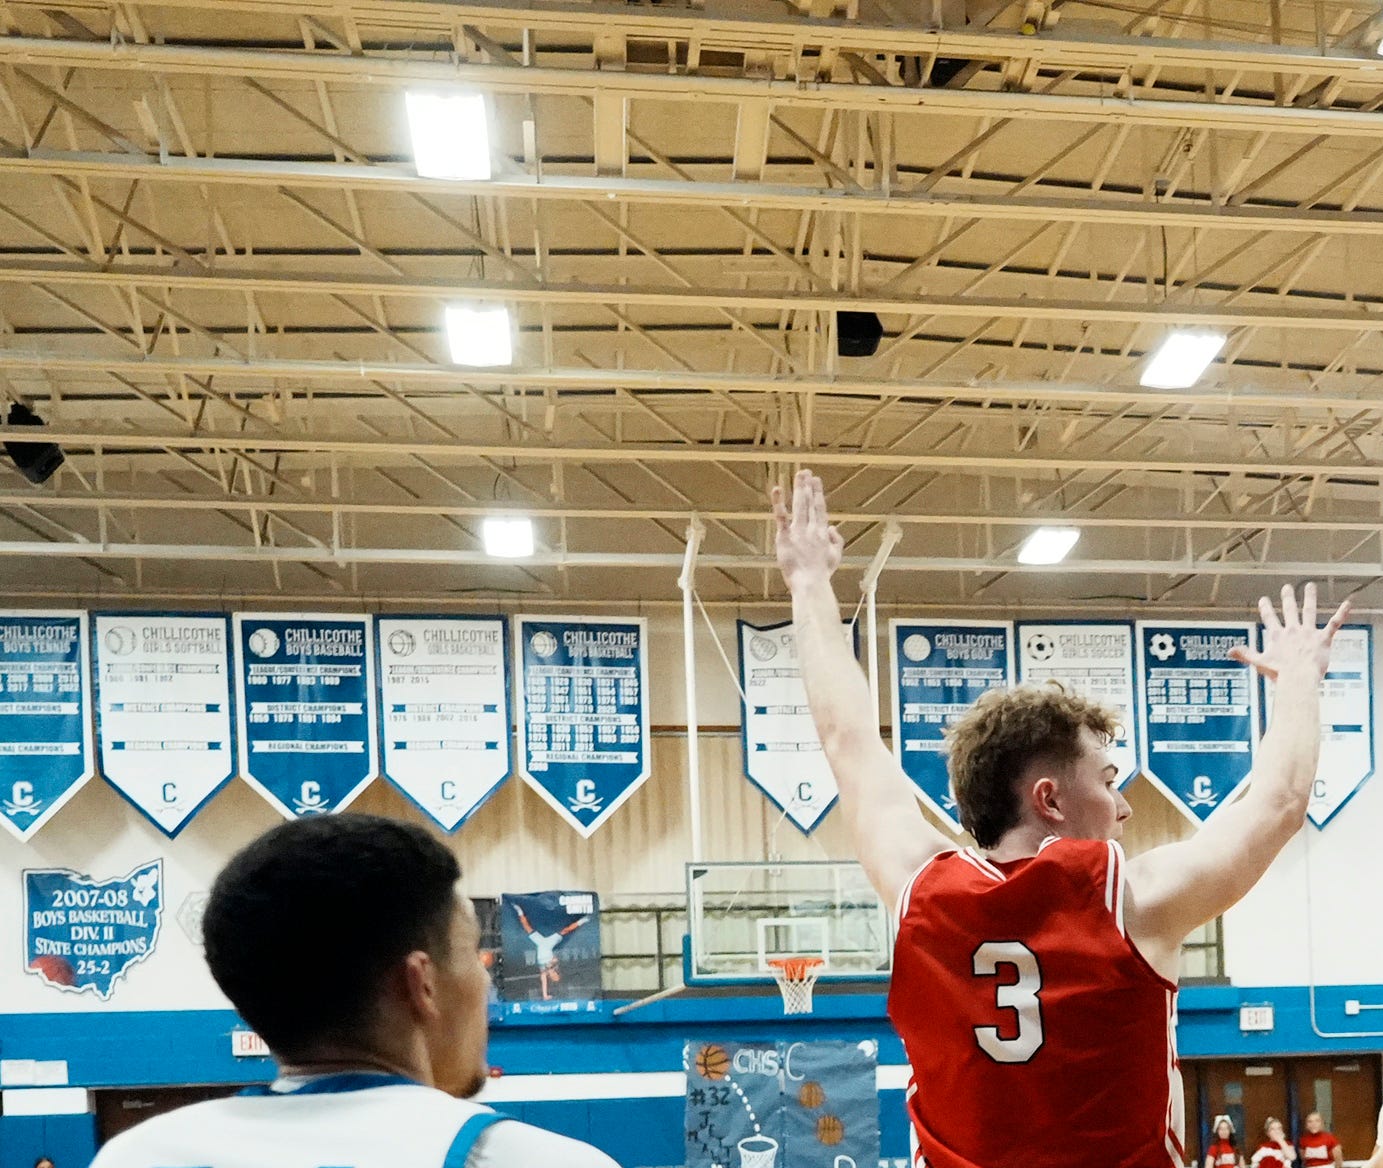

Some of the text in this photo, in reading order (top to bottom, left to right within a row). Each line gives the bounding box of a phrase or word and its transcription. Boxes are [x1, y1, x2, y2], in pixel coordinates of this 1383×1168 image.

[142, 627, 221, 640] CHILLICOTHE
[285, 628, 363, 643] CHILLICOTHE
[423, 629, 499, 642] CHILLICOTHE
[563, 630, 638, 645] CHILLICOTHE
[1059, 634, 1127, 647] CHILLICOTHE
[4, 641, 31, 653] BOYS
[143, 642, 223, 654] GIRLS SOFTBALL
[935, 634, 1005, 648] CHILLICOTHE
[1180, 635, 1247, 649] CHILLICOTHE
[286, 643, 363, 657] BOYS BASEBALL
[946, 649, 994, 660] BOYS GOLF
[576, 779, 595, 801] C
[1193, 776, 1212, 796] C
[52, 889, 128, 907] 2007-08
[33, 911, 148, 929] BOYS BASKETBALL
[71, 926, 114, 940] DIV. II
[35, 937, 147, 956] STATE CHAMPIONS
[77, 960, 110, 975] 25-2
[972, 940, 1045, 1064] 3
[733, 1048, 780, 1077] CHS
